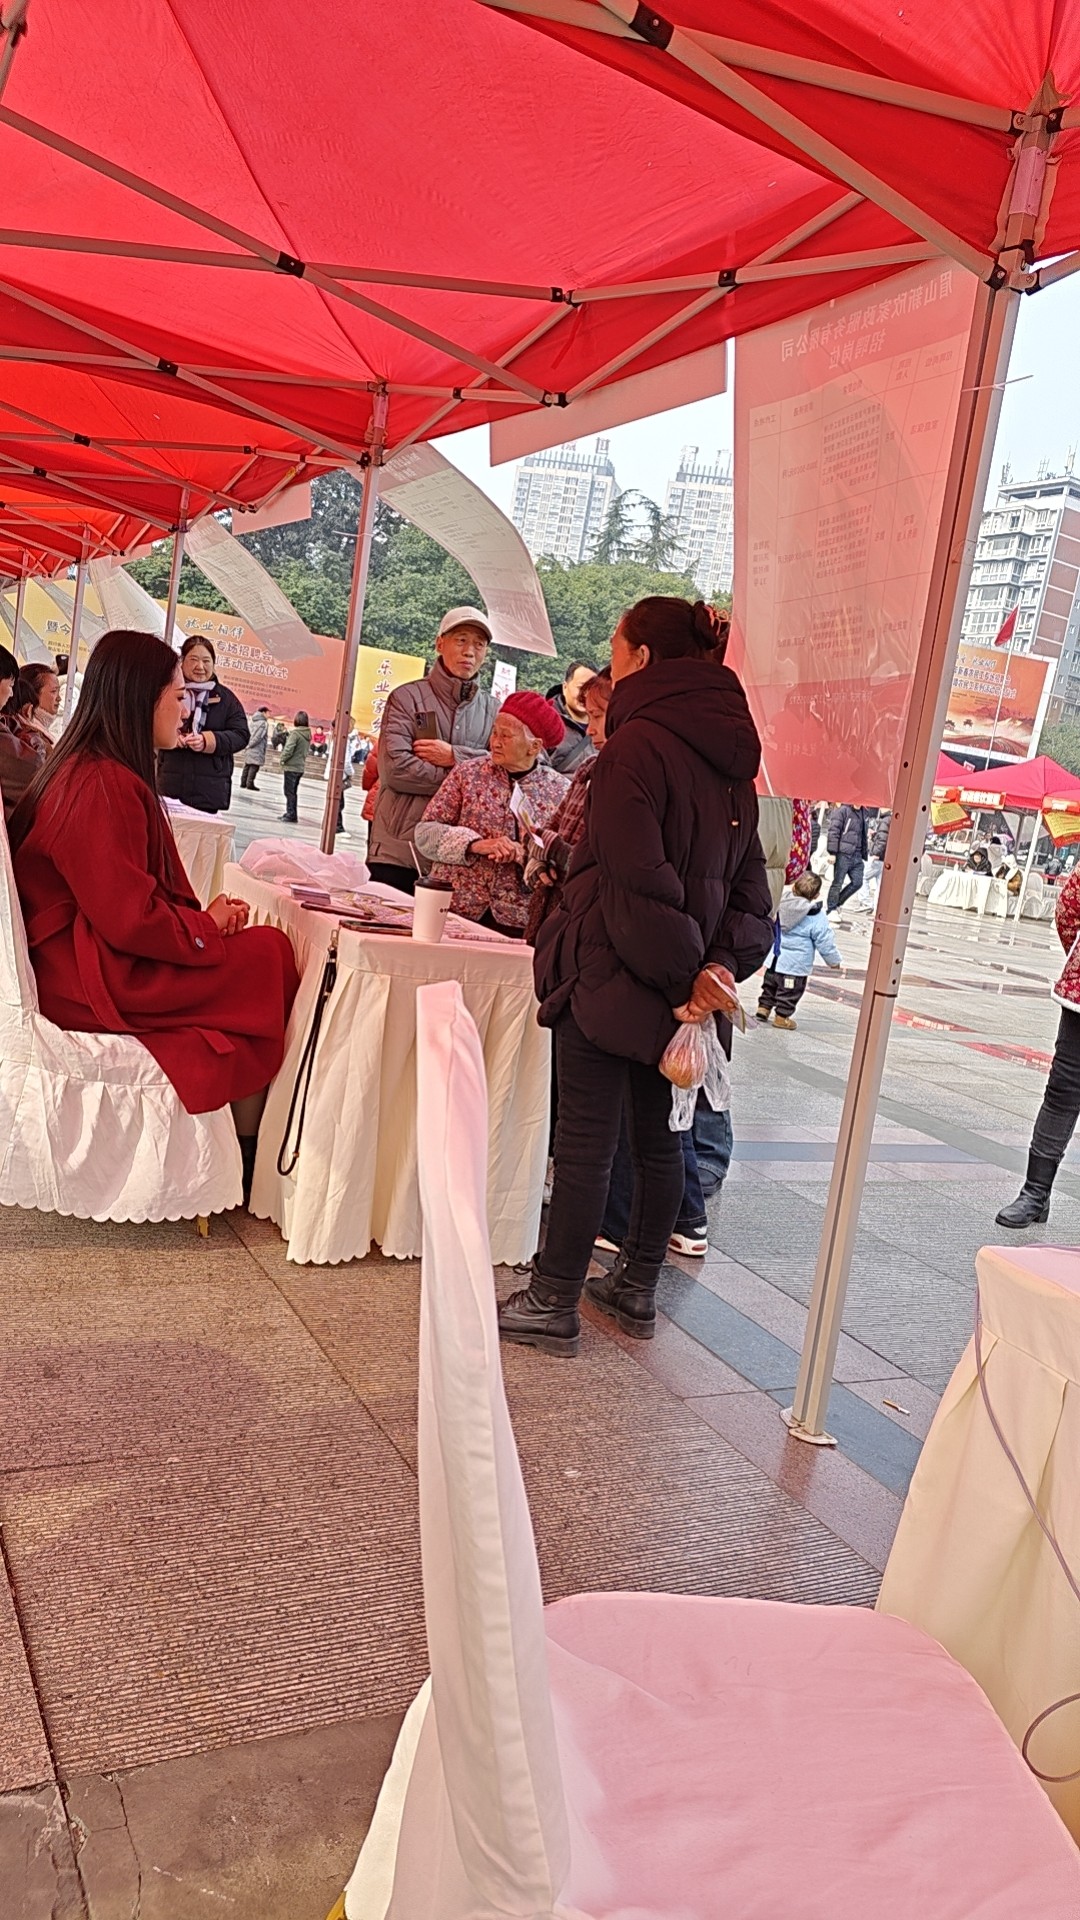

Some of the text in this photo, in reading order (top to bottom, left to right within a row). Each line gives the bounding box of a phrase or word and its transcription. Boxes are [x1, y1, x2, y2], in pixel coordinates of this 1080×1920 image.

[185, 616, 245, 641] 就业相伴
[210, 640, 273, 662] 专场招聘会
